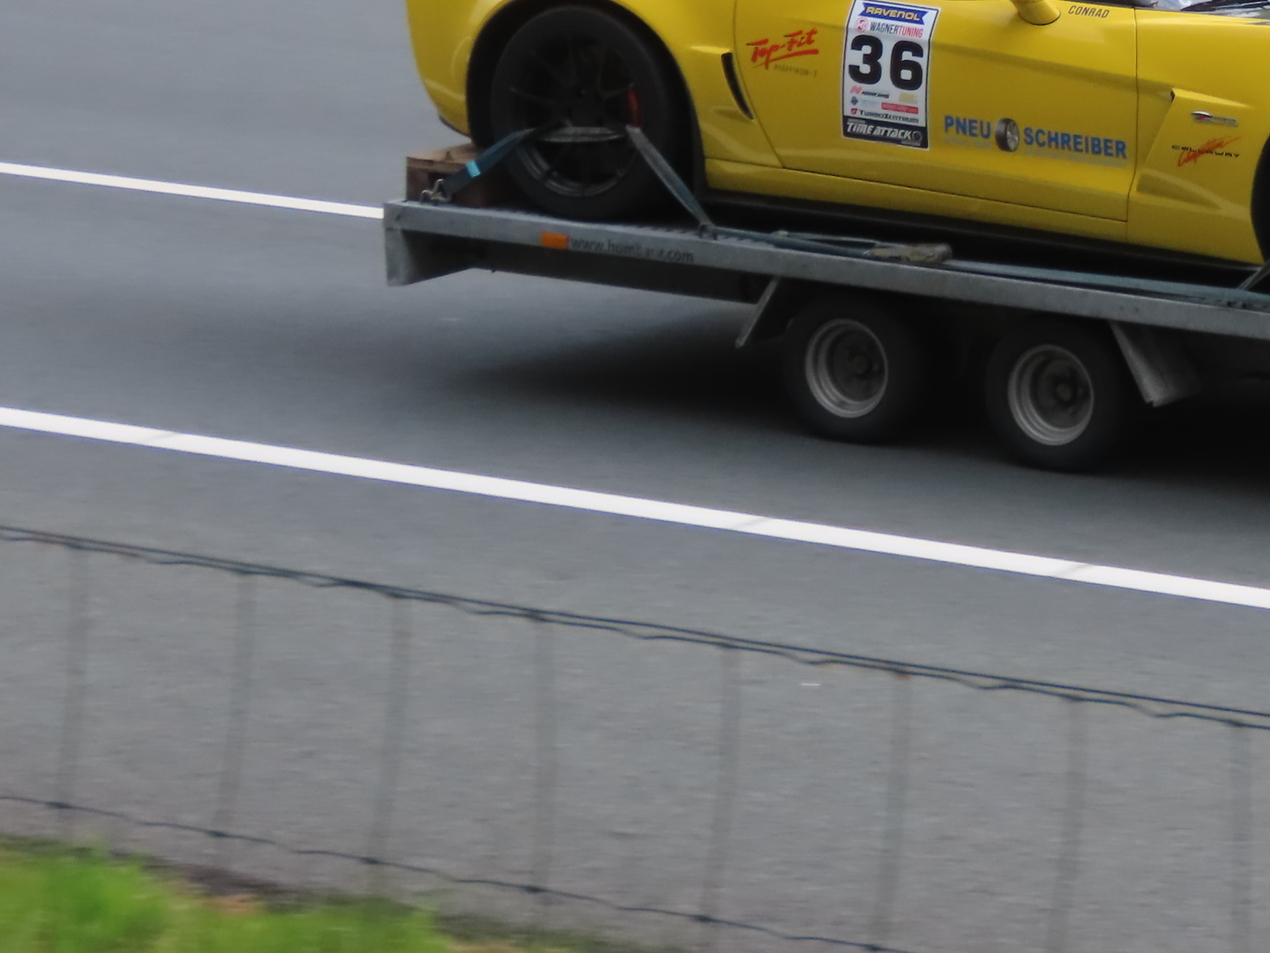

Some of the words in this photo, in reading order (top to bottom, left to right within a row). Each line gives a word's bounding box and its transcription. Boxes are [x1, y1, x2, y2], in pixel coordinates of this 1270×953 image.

[1068, 4, 1110, 19] CONRAD
[848, 34, 924, 91] 36
[944, 114, 991, 140] PNEU
[1023, 126, 1128, 160] SCHREIBER
